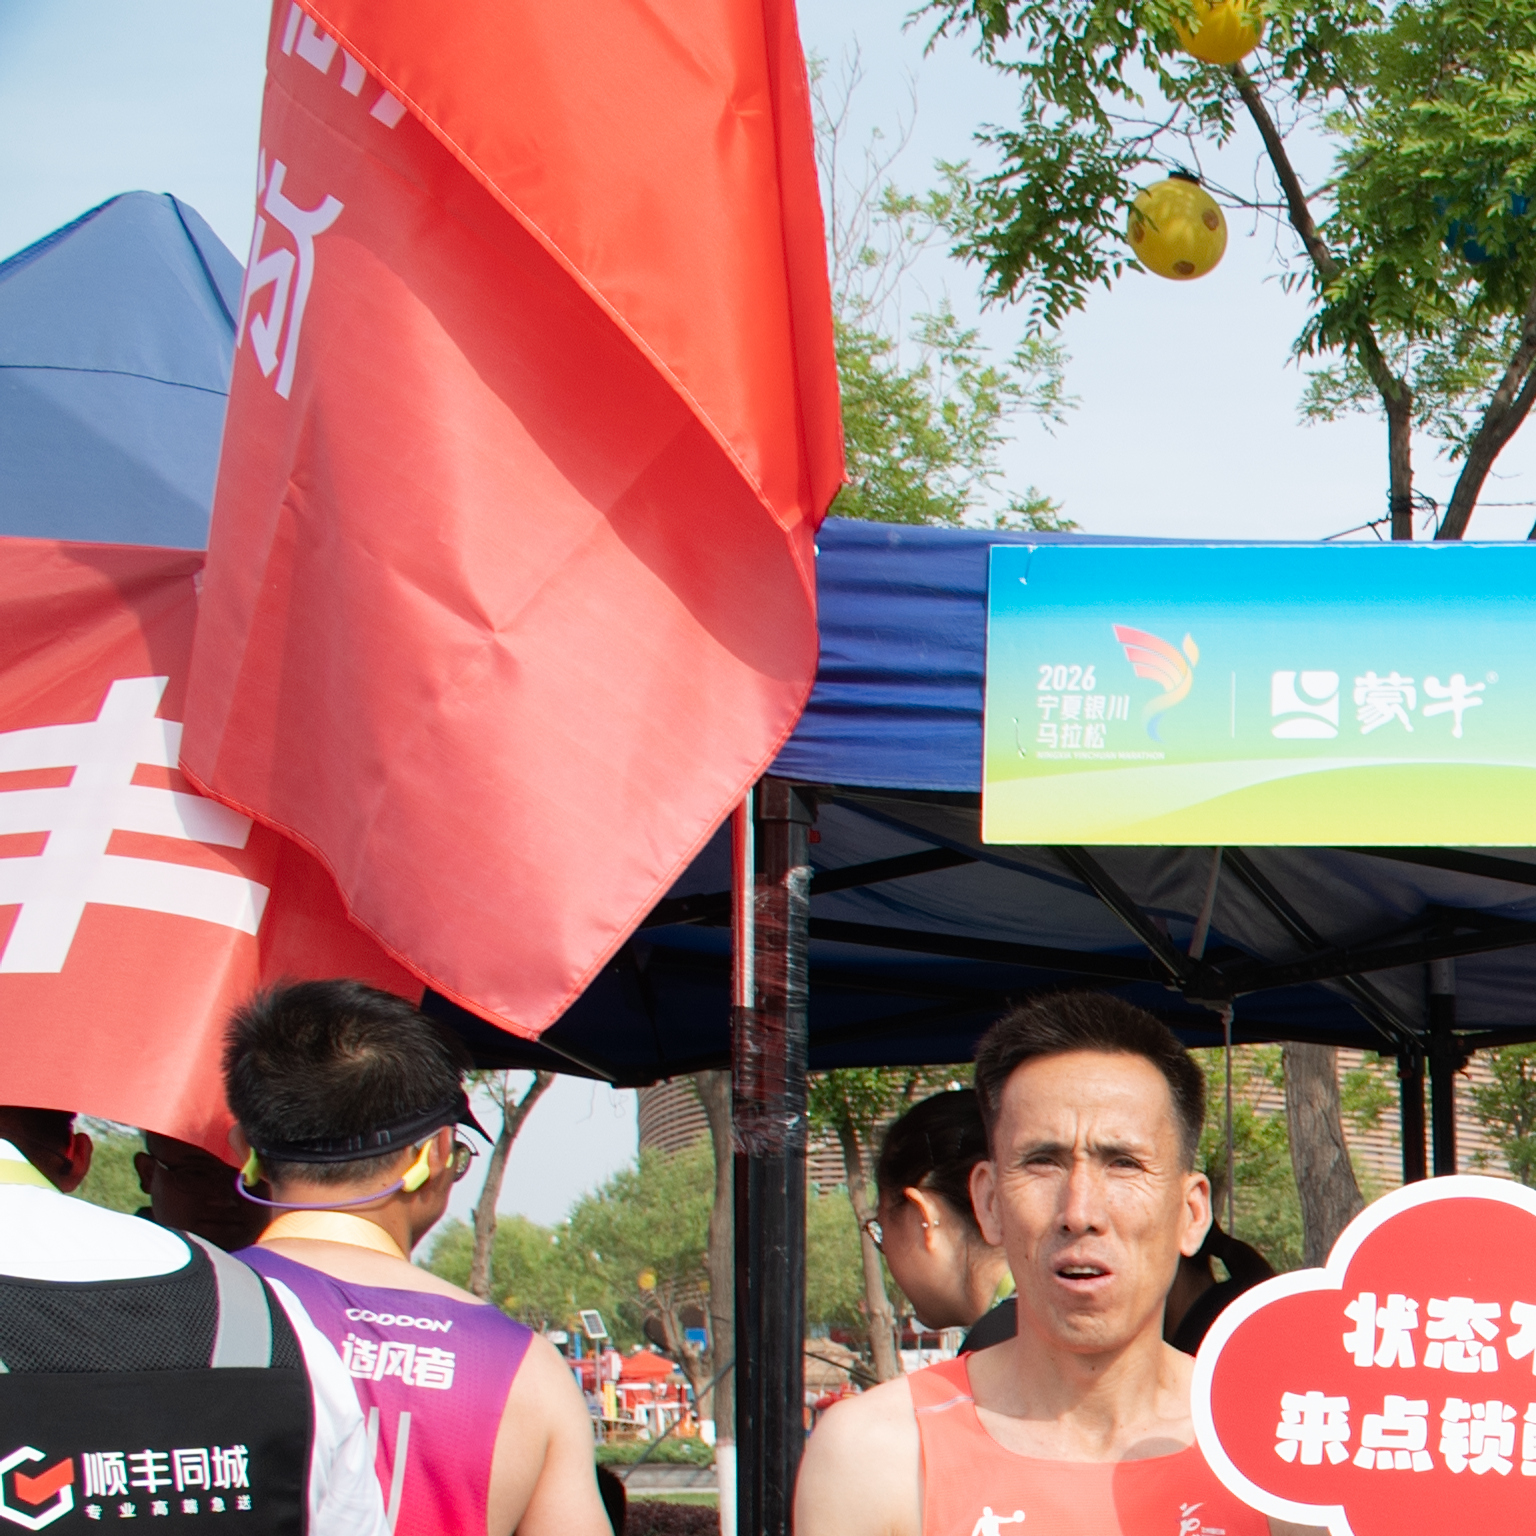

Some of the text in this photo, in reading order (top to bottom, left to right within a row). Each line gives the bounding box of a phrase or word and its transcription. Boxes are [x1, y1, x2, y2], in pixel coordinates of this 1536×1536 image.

[1037, 664, 1096, 691] 2026
[1036, 694, 1130, 721] 宁夏银川
[1353, 671, 1487, 738] 蒙牛
[1036, 722, 1107, 749] 马拉松
[345, 1307, 454, 1334] CODOON
[82, 1444, 250, 1498] 顺丰同城
[84, 1494, 252, 1520] 专业高端急送
